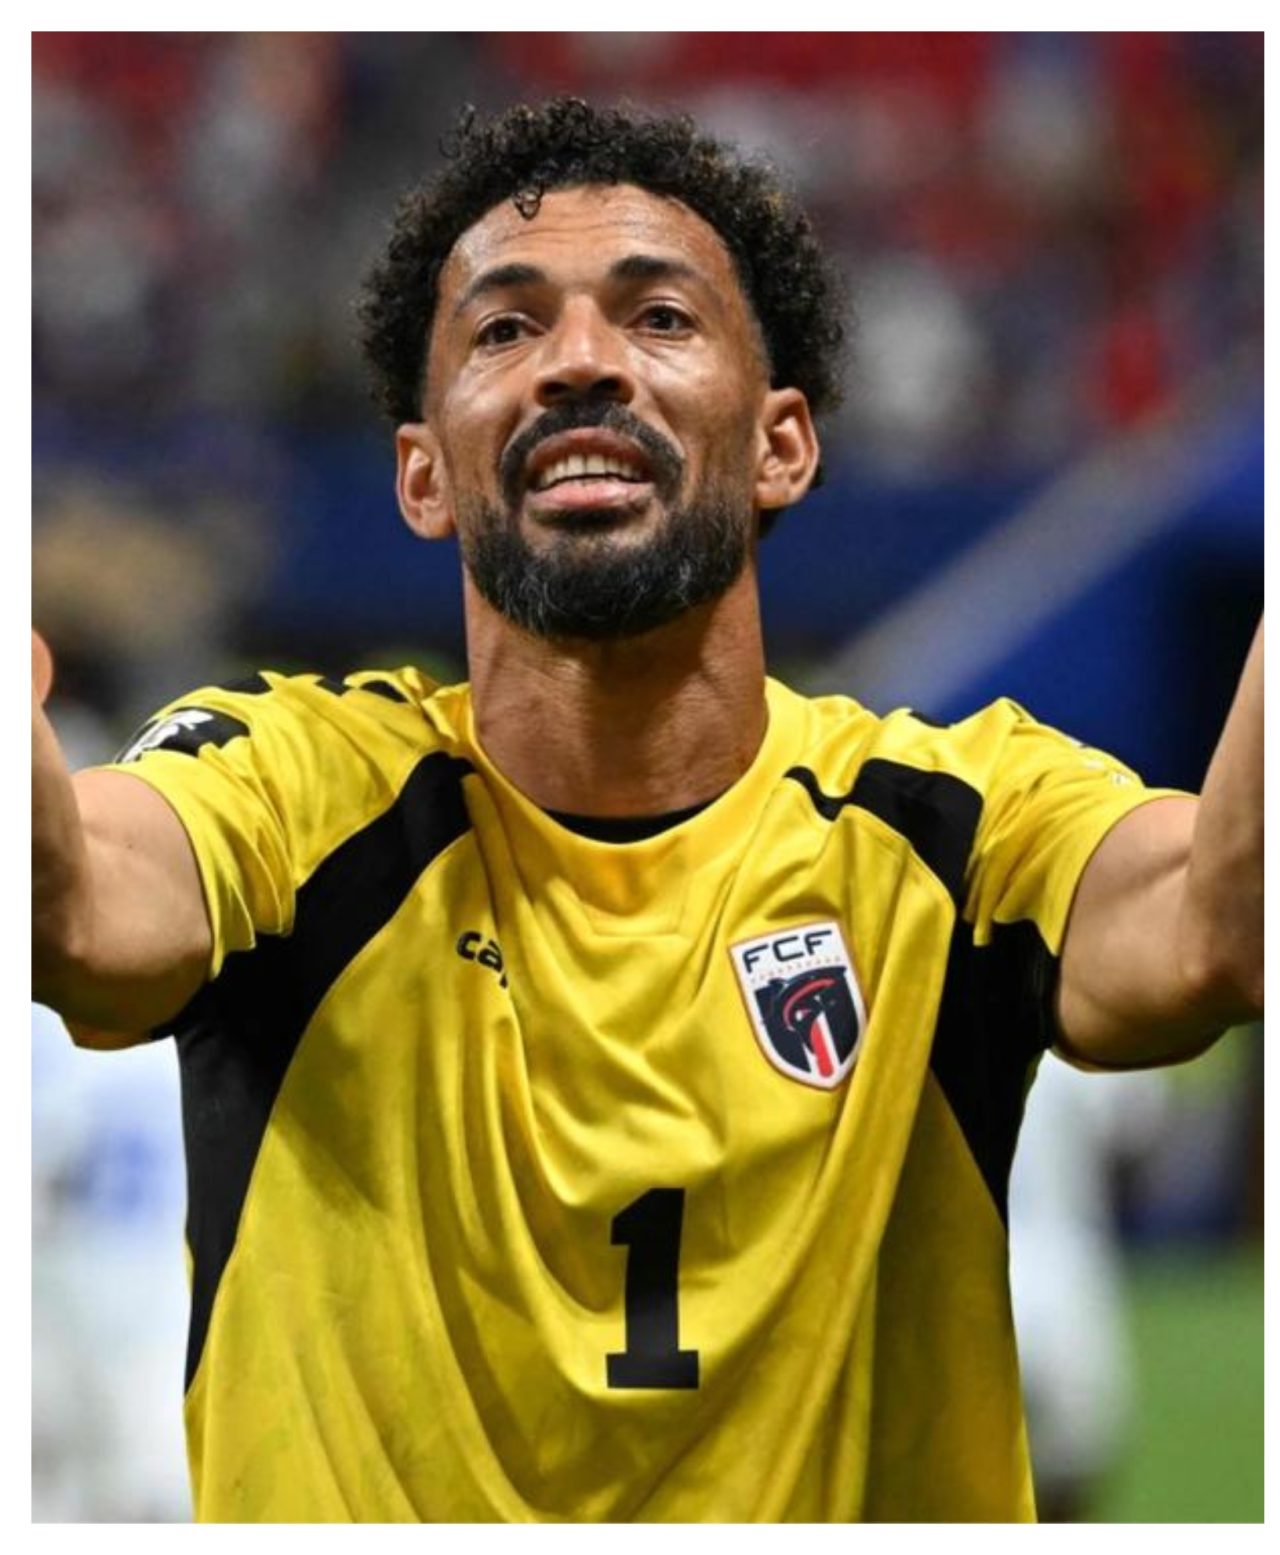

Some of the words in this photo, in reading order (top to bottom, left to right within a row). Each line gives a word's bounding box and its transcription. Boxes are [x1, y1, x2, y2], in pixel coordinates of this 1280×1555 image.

[456, 930, 508, 989] ca
[742, 930, 832, 973] FCF
[605, 1187, 699, 1389] 1
